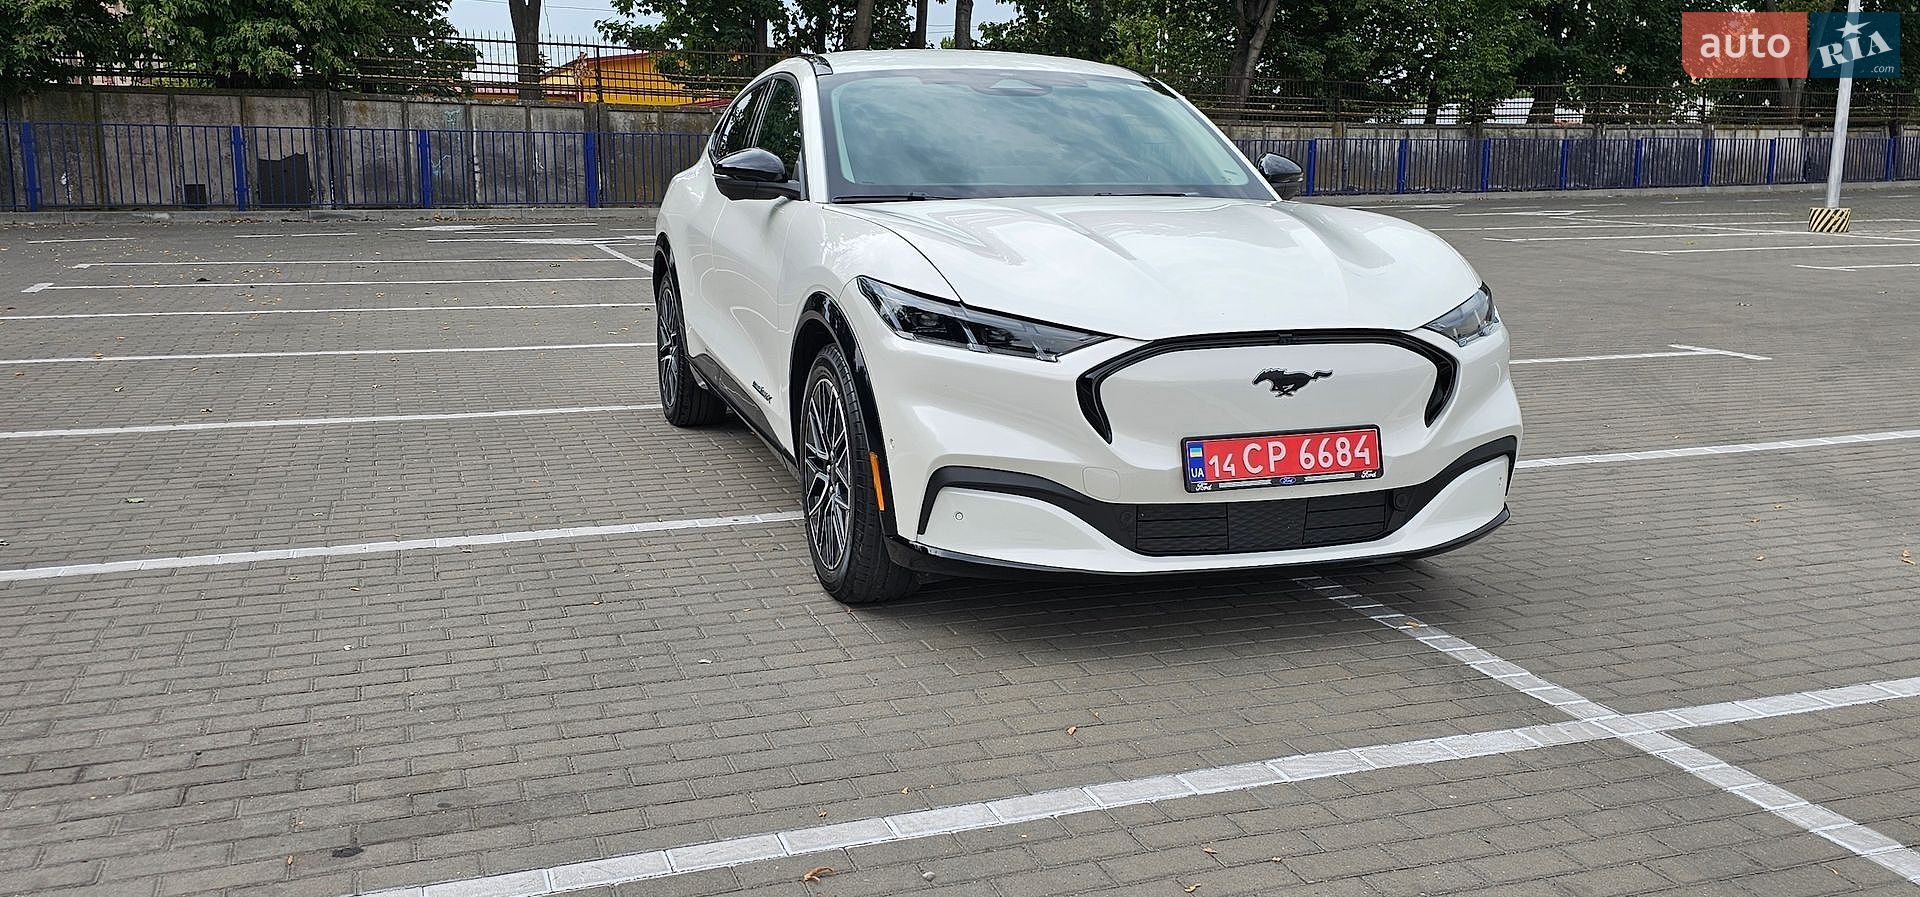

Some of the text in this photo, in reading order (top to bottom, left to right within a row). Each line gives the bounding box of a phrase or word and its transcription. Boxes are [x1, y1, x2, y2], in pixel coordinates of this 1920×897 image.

[1209, 435, 1371, 478] 14 CP 6684
[1191, 468, 1205, 478] UA
[1195, 483, 1212, 491] Ford
[1361, 470, 1377, 478] Ford
